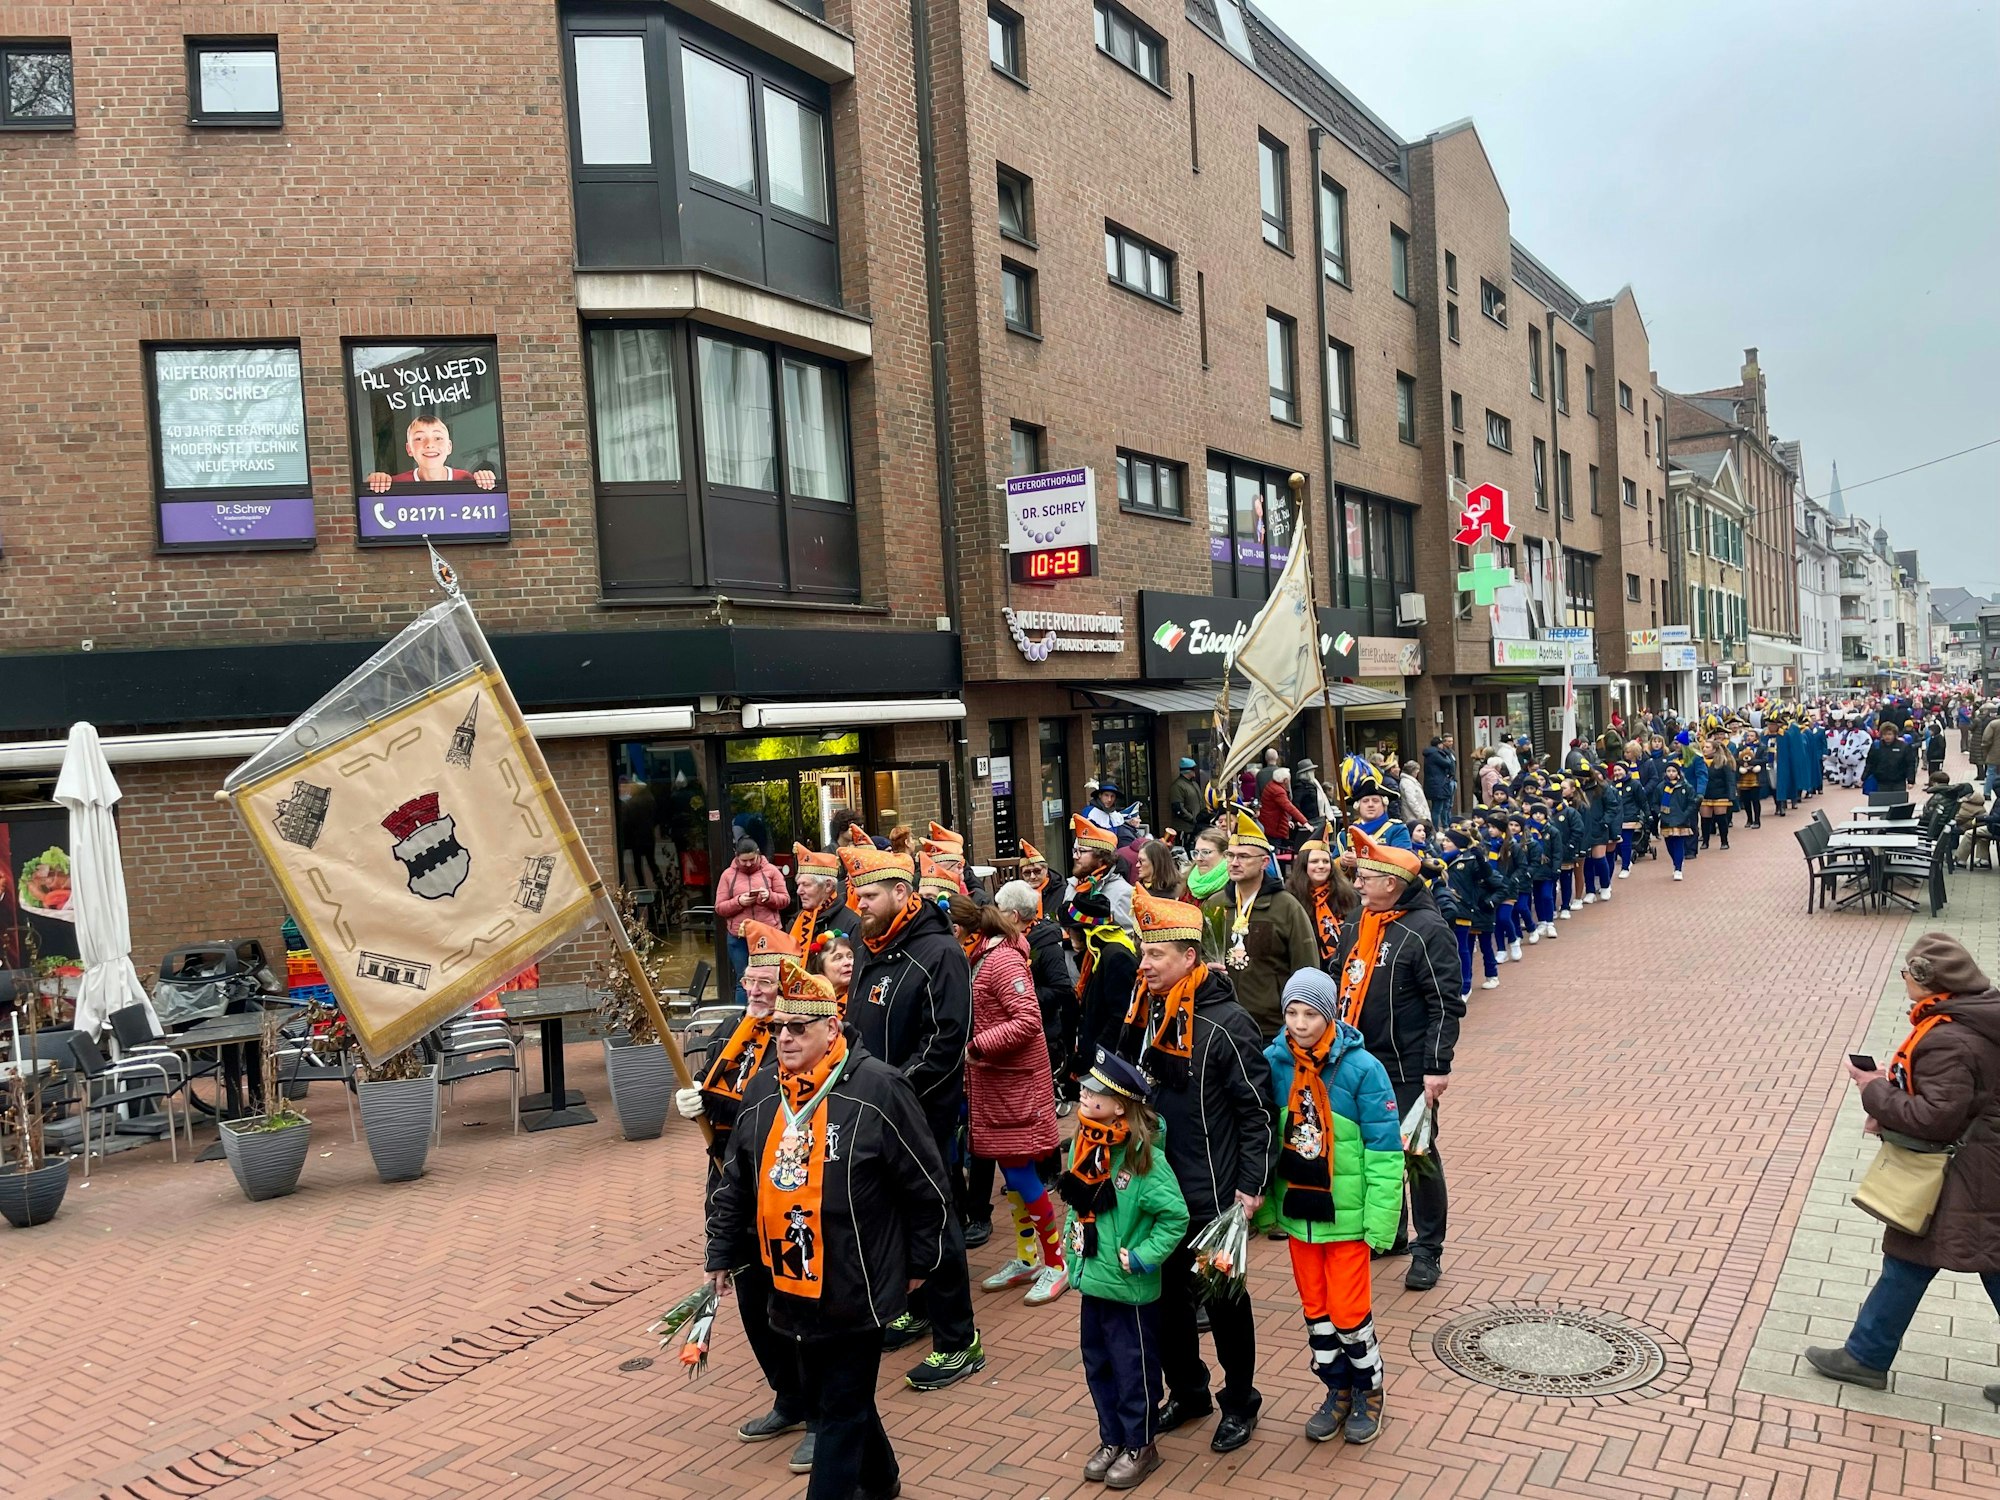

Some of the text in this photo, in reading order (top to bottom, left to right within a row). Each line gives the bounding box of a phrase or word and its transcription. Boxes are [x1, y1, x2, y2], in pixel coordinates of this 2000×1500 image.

[160, 361, 298, 380] KIEFERORTHOPÄDIE
[361, 357, 487, 391] ALL YOU NEED
[189, 385, 270, 401] DR. SCHREY
[386, 377, 471, 410] IS LAUGH!
[166, 423, 299, 438] 40 JAHRE ERFAHRUNG
[170, 440, 299, 455] MODERNSTE TECHNIK
[196, 459, 275, 473] NEUE PRAXIS
[1009, 473, 1085, 492] KIEFERORTHOPÄDIE
[233, 503, 271, 516] Schrey
[397, 507, 445, 521] 02171
[461, 505, 496, 520] 2411
[1022, 500, 1086, 519] DR. SCHREY
[1031, 550, 1080, 577] 10:29
[1017, 611, 1125, 633] KIEFERORTHOPÄDIE
[1056, 638, 1084, 652] PRAXIS
[1098, 640, 1125, 652] SCHREY
[1539, 645, 1563, 662] Apotheke
[979, 760, 987, 771] 38
